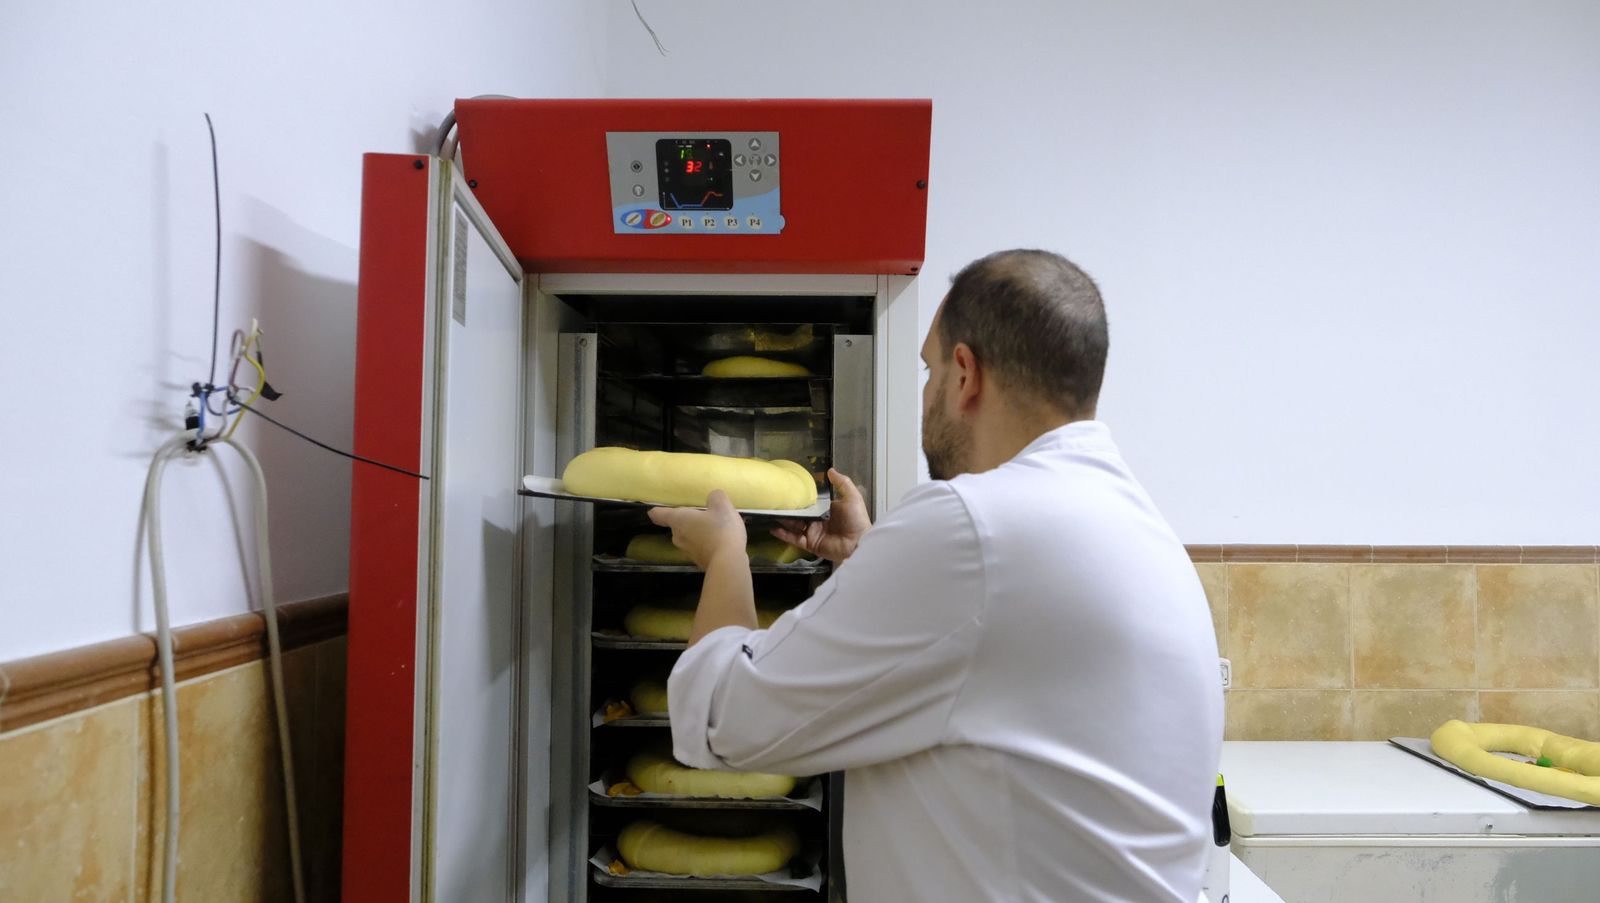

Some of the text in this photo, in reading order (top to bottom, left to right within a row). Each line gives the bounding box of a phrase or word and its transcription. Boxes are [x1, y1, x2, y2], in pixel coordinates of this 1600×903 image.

[685, 160, 703, 173] 32
[682, 219, 761, 227] P1 P2 P3 P4
